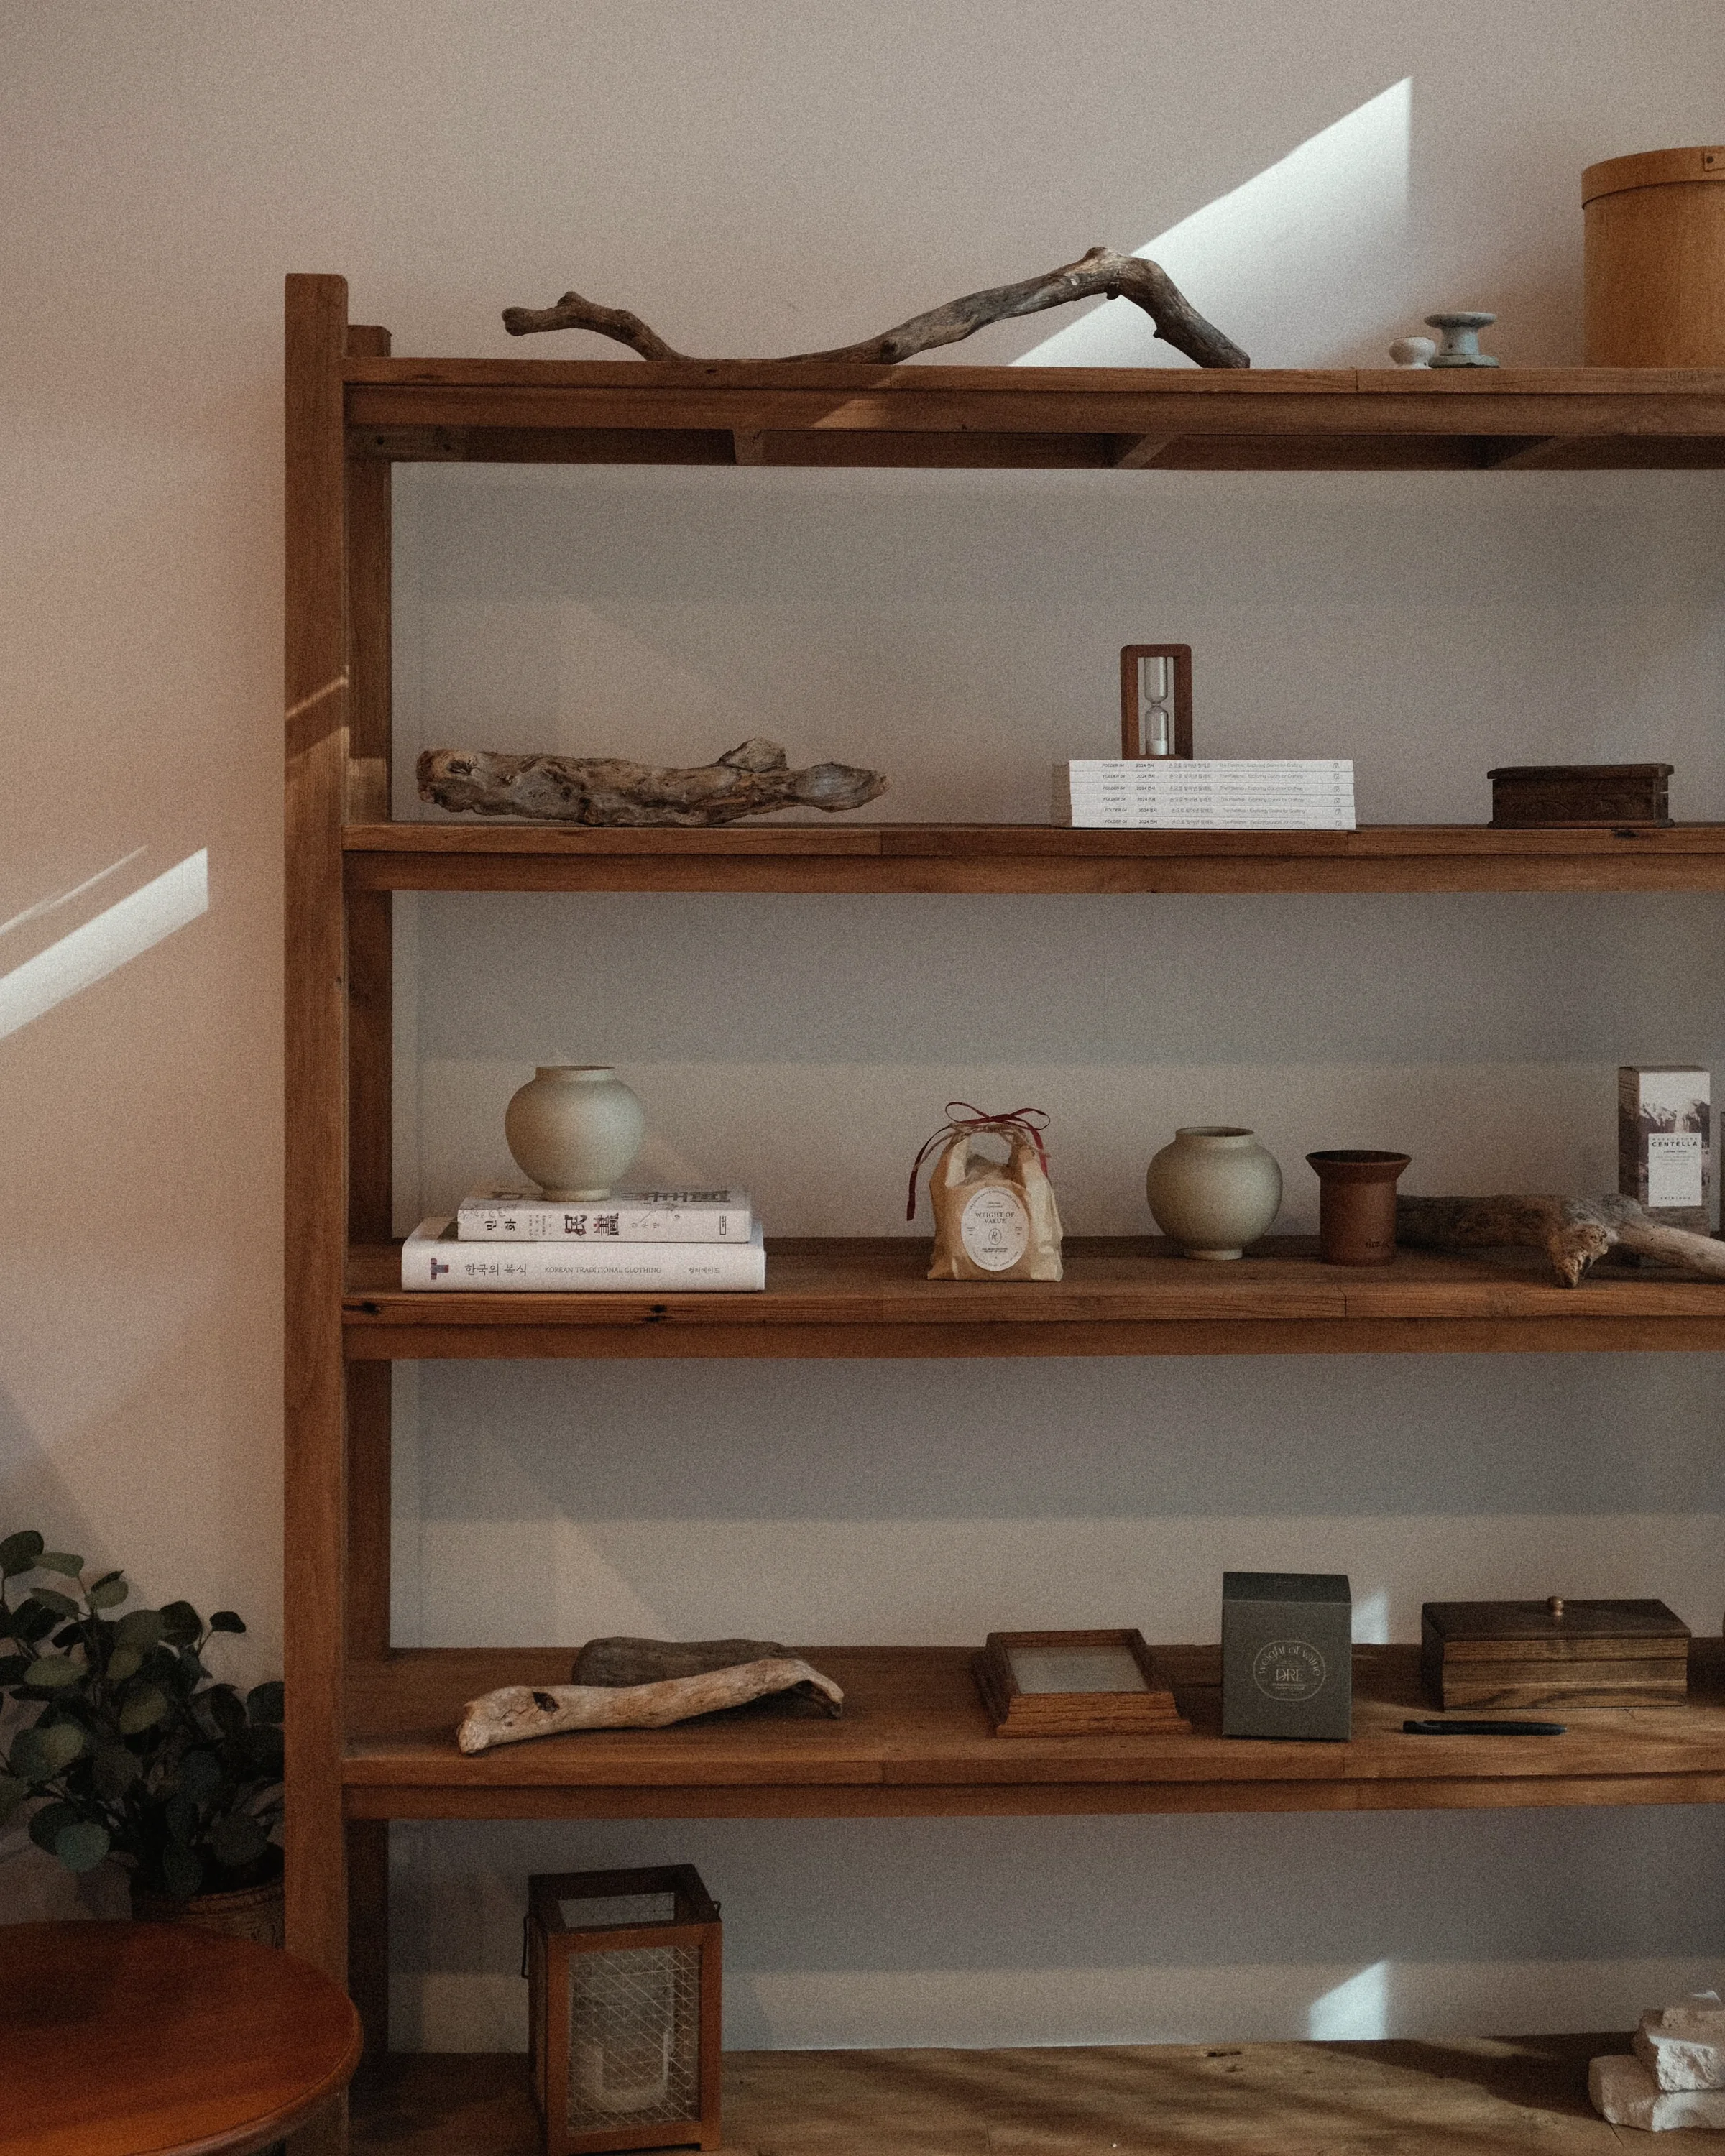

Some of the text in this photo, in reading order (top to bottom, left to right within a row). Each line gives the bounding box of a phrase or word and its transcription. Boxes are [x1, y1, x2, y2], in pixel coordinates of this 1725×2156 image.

[464, 1263, 499, 1276] 한국의
[503, 1263, 527, 1276] 복식
[1258, 1645, 1320, 1677] weight of value
